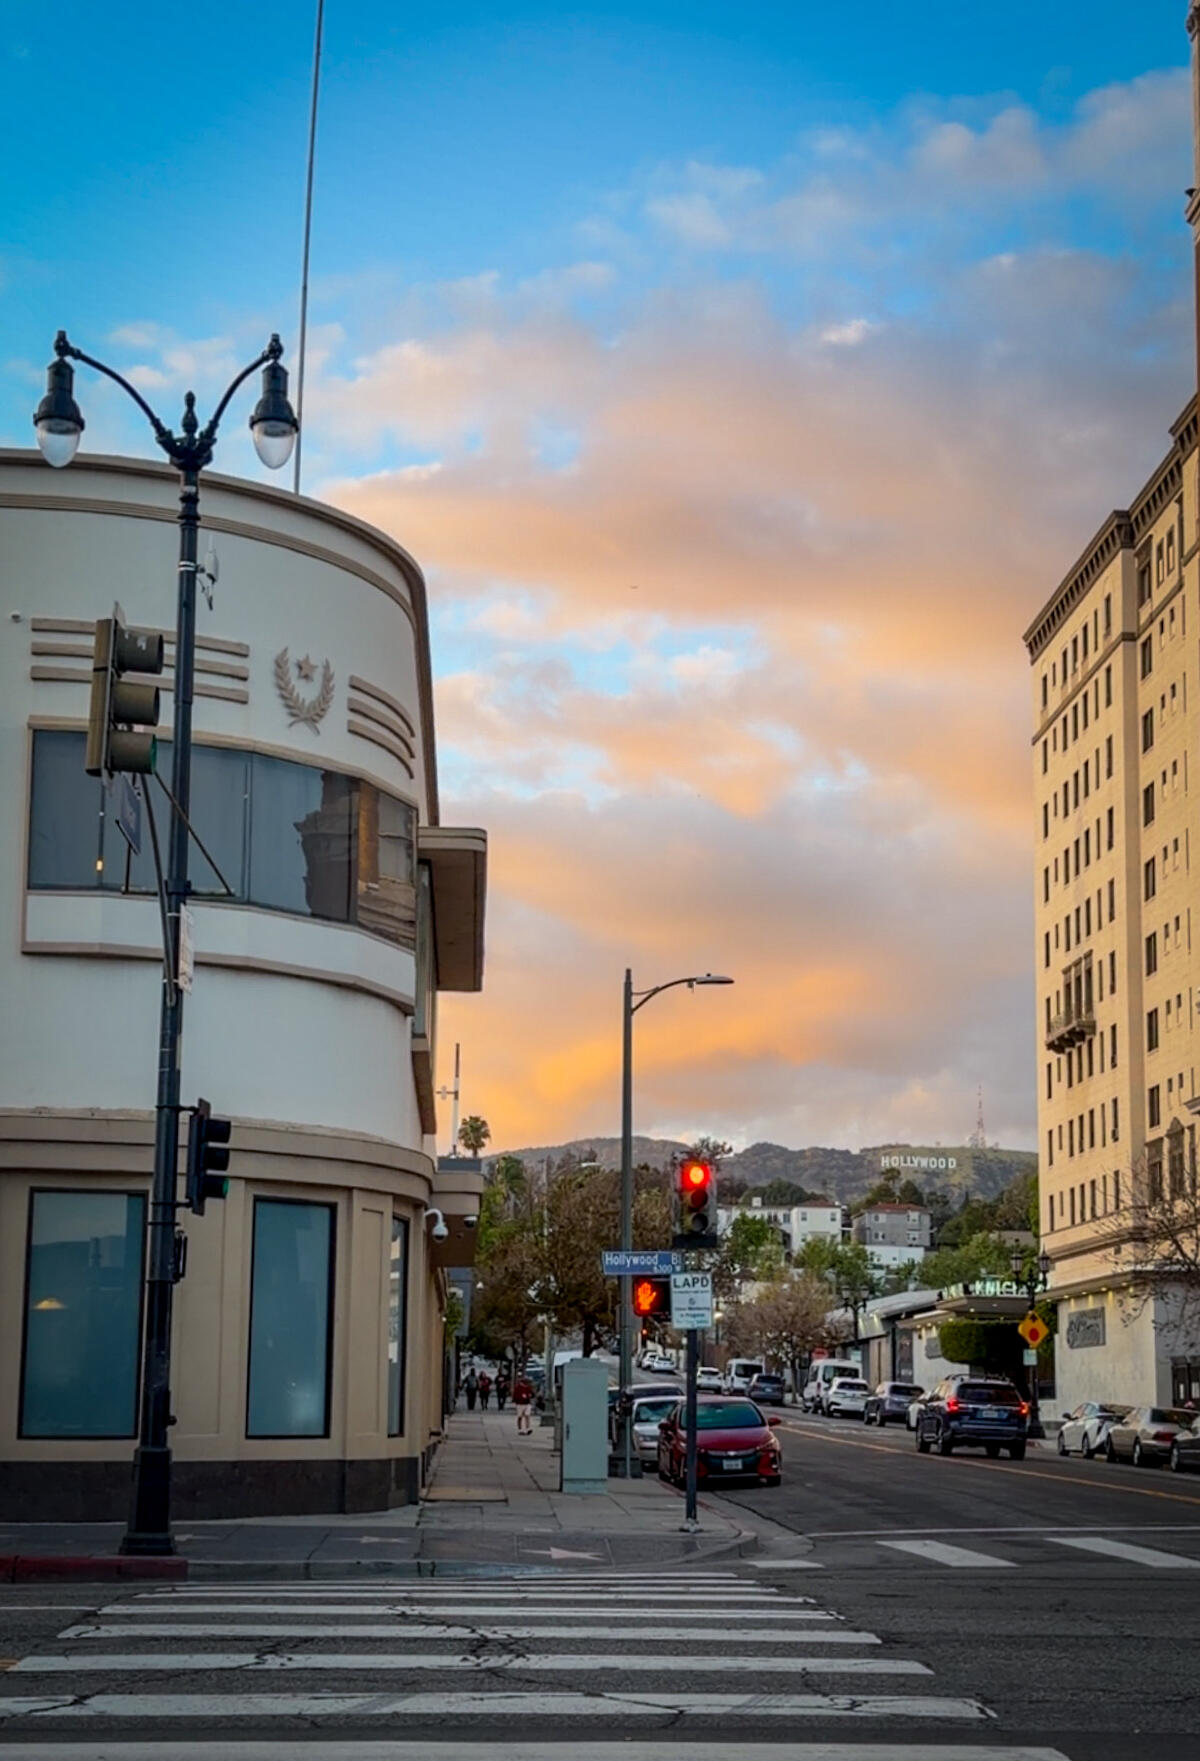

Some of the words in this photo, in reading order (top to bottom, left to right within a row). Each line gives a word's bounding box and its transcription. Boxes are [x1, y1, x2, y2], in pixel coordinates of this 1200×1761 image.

[881, 1155, 957, 1168] HOLLYWOOD
[605, 1253, 658, 1267] Hollywood
[673, 1276, 709, 1288] LAPD
